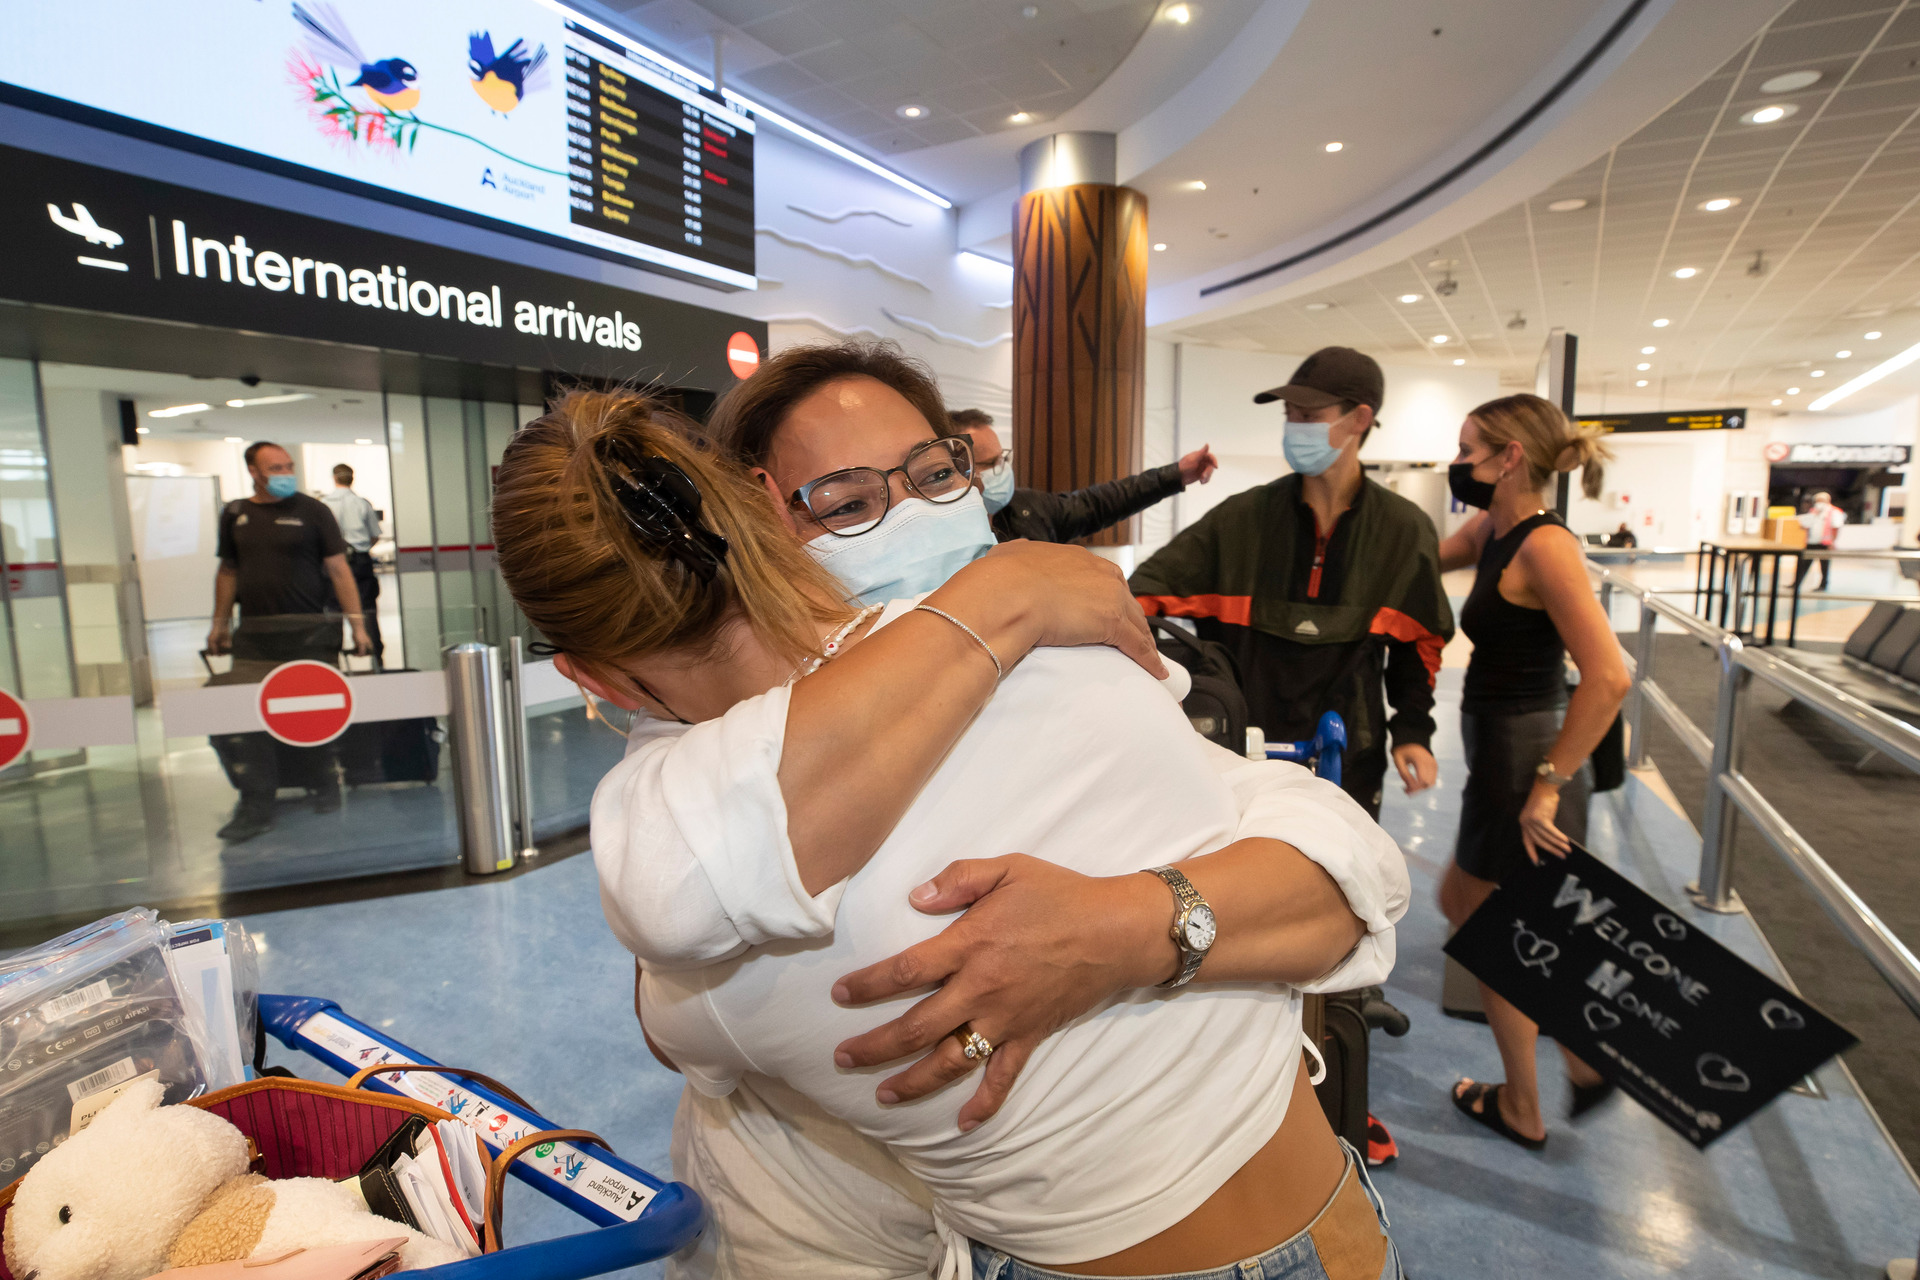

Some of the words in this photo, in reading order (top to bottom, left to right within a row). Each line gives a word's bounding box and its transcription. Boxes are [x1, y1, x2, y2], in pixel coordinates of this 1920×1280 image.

[599, 95, 638, 120] Melbourne
[600, 142, 639, 166] Melbourne
[503, 173, 546, 194] Auckland
[503, 184, 535, 200] Airport
[171, 219, 502, 328] International
[514, 300, 642, 352] arrivals
[105, 1018, 120, 1028] REF
[538, 1143, 553, 1155] GO
[586, 1180, 623, 1204] Auckland
[602, 1175, 630, 1195] Airport
